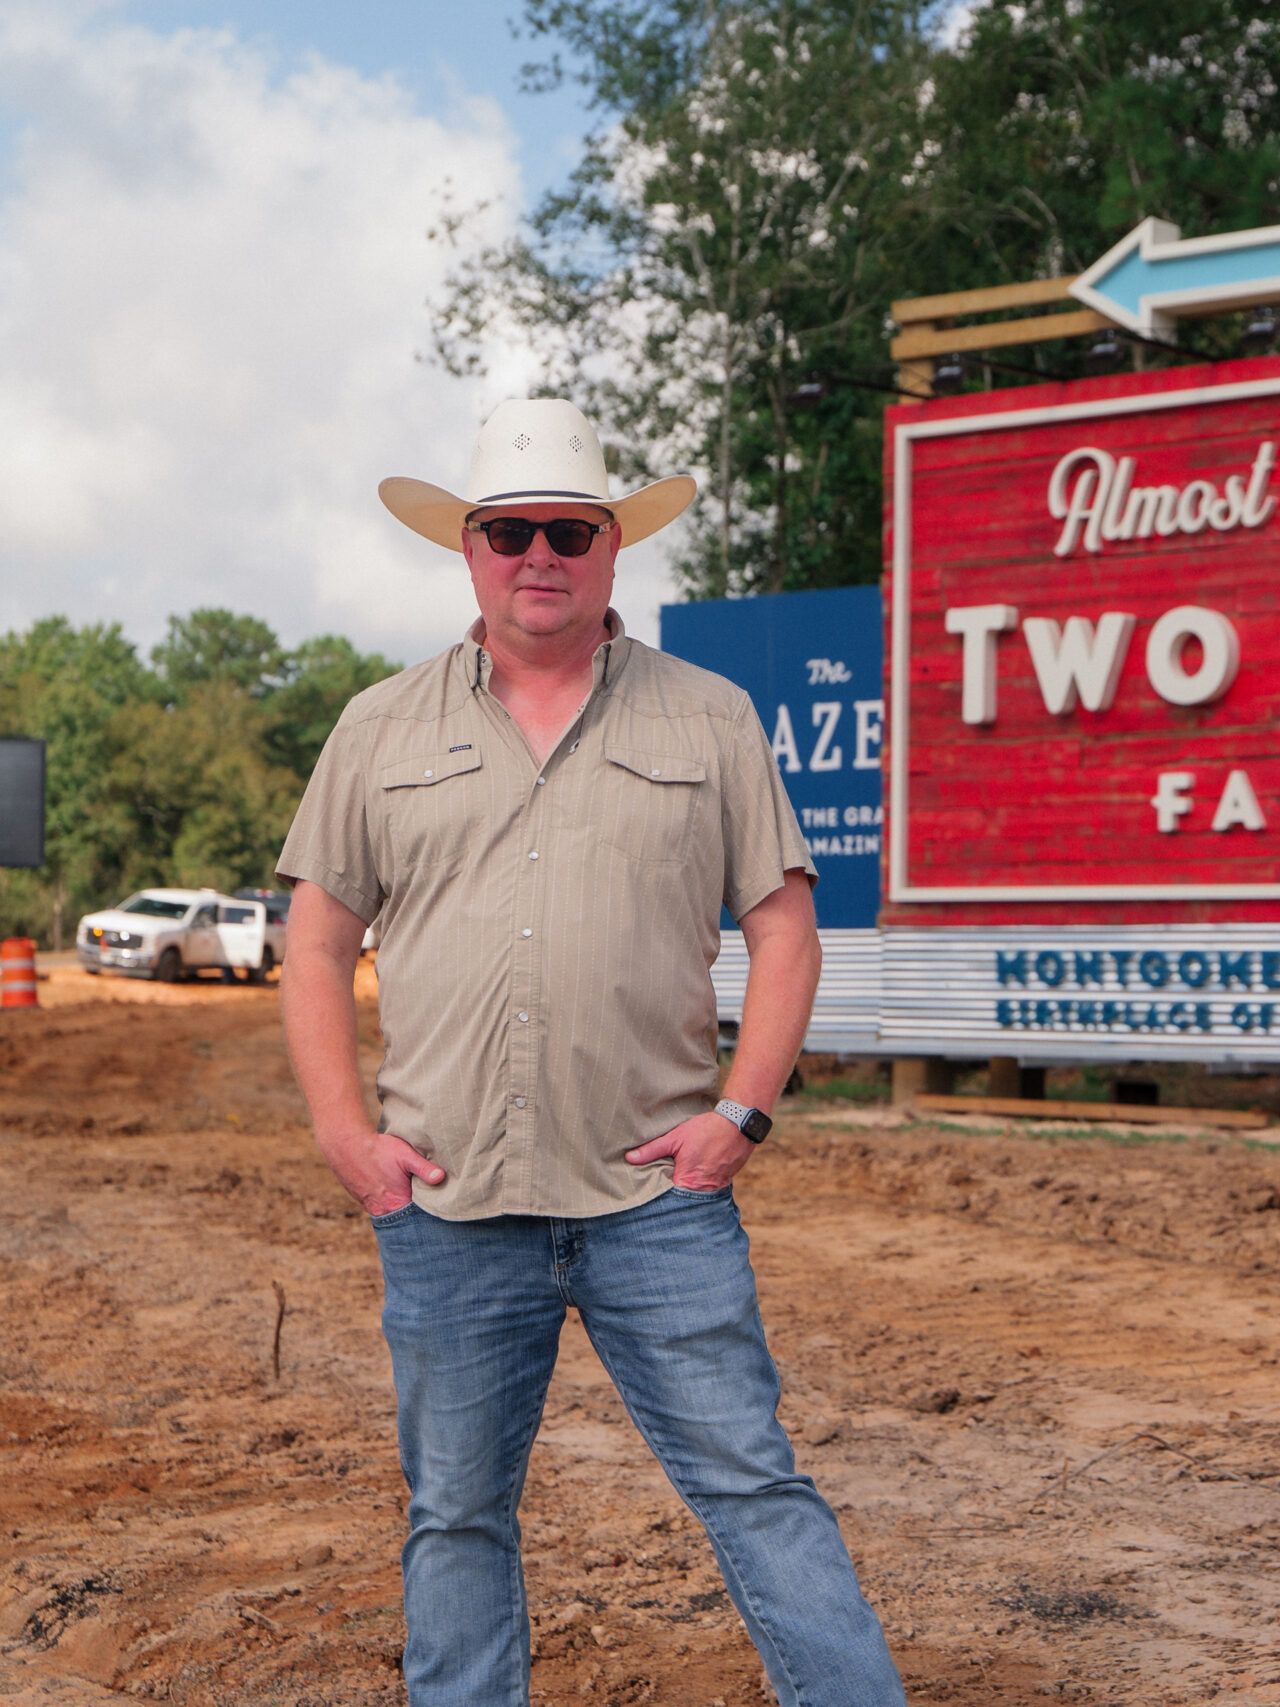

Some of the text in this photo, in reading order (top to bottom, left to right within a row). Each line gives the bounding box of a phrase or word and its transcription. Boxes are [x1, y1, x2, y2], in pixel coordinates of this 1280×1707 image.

[1048, 441, 1277, 556] Almost
[806, 657, 853, 686] The
[945, 603, 1239, 725] TWO
[801, 806, 838, 828] THE
[1231, 1002, 1274, 1033] OF
